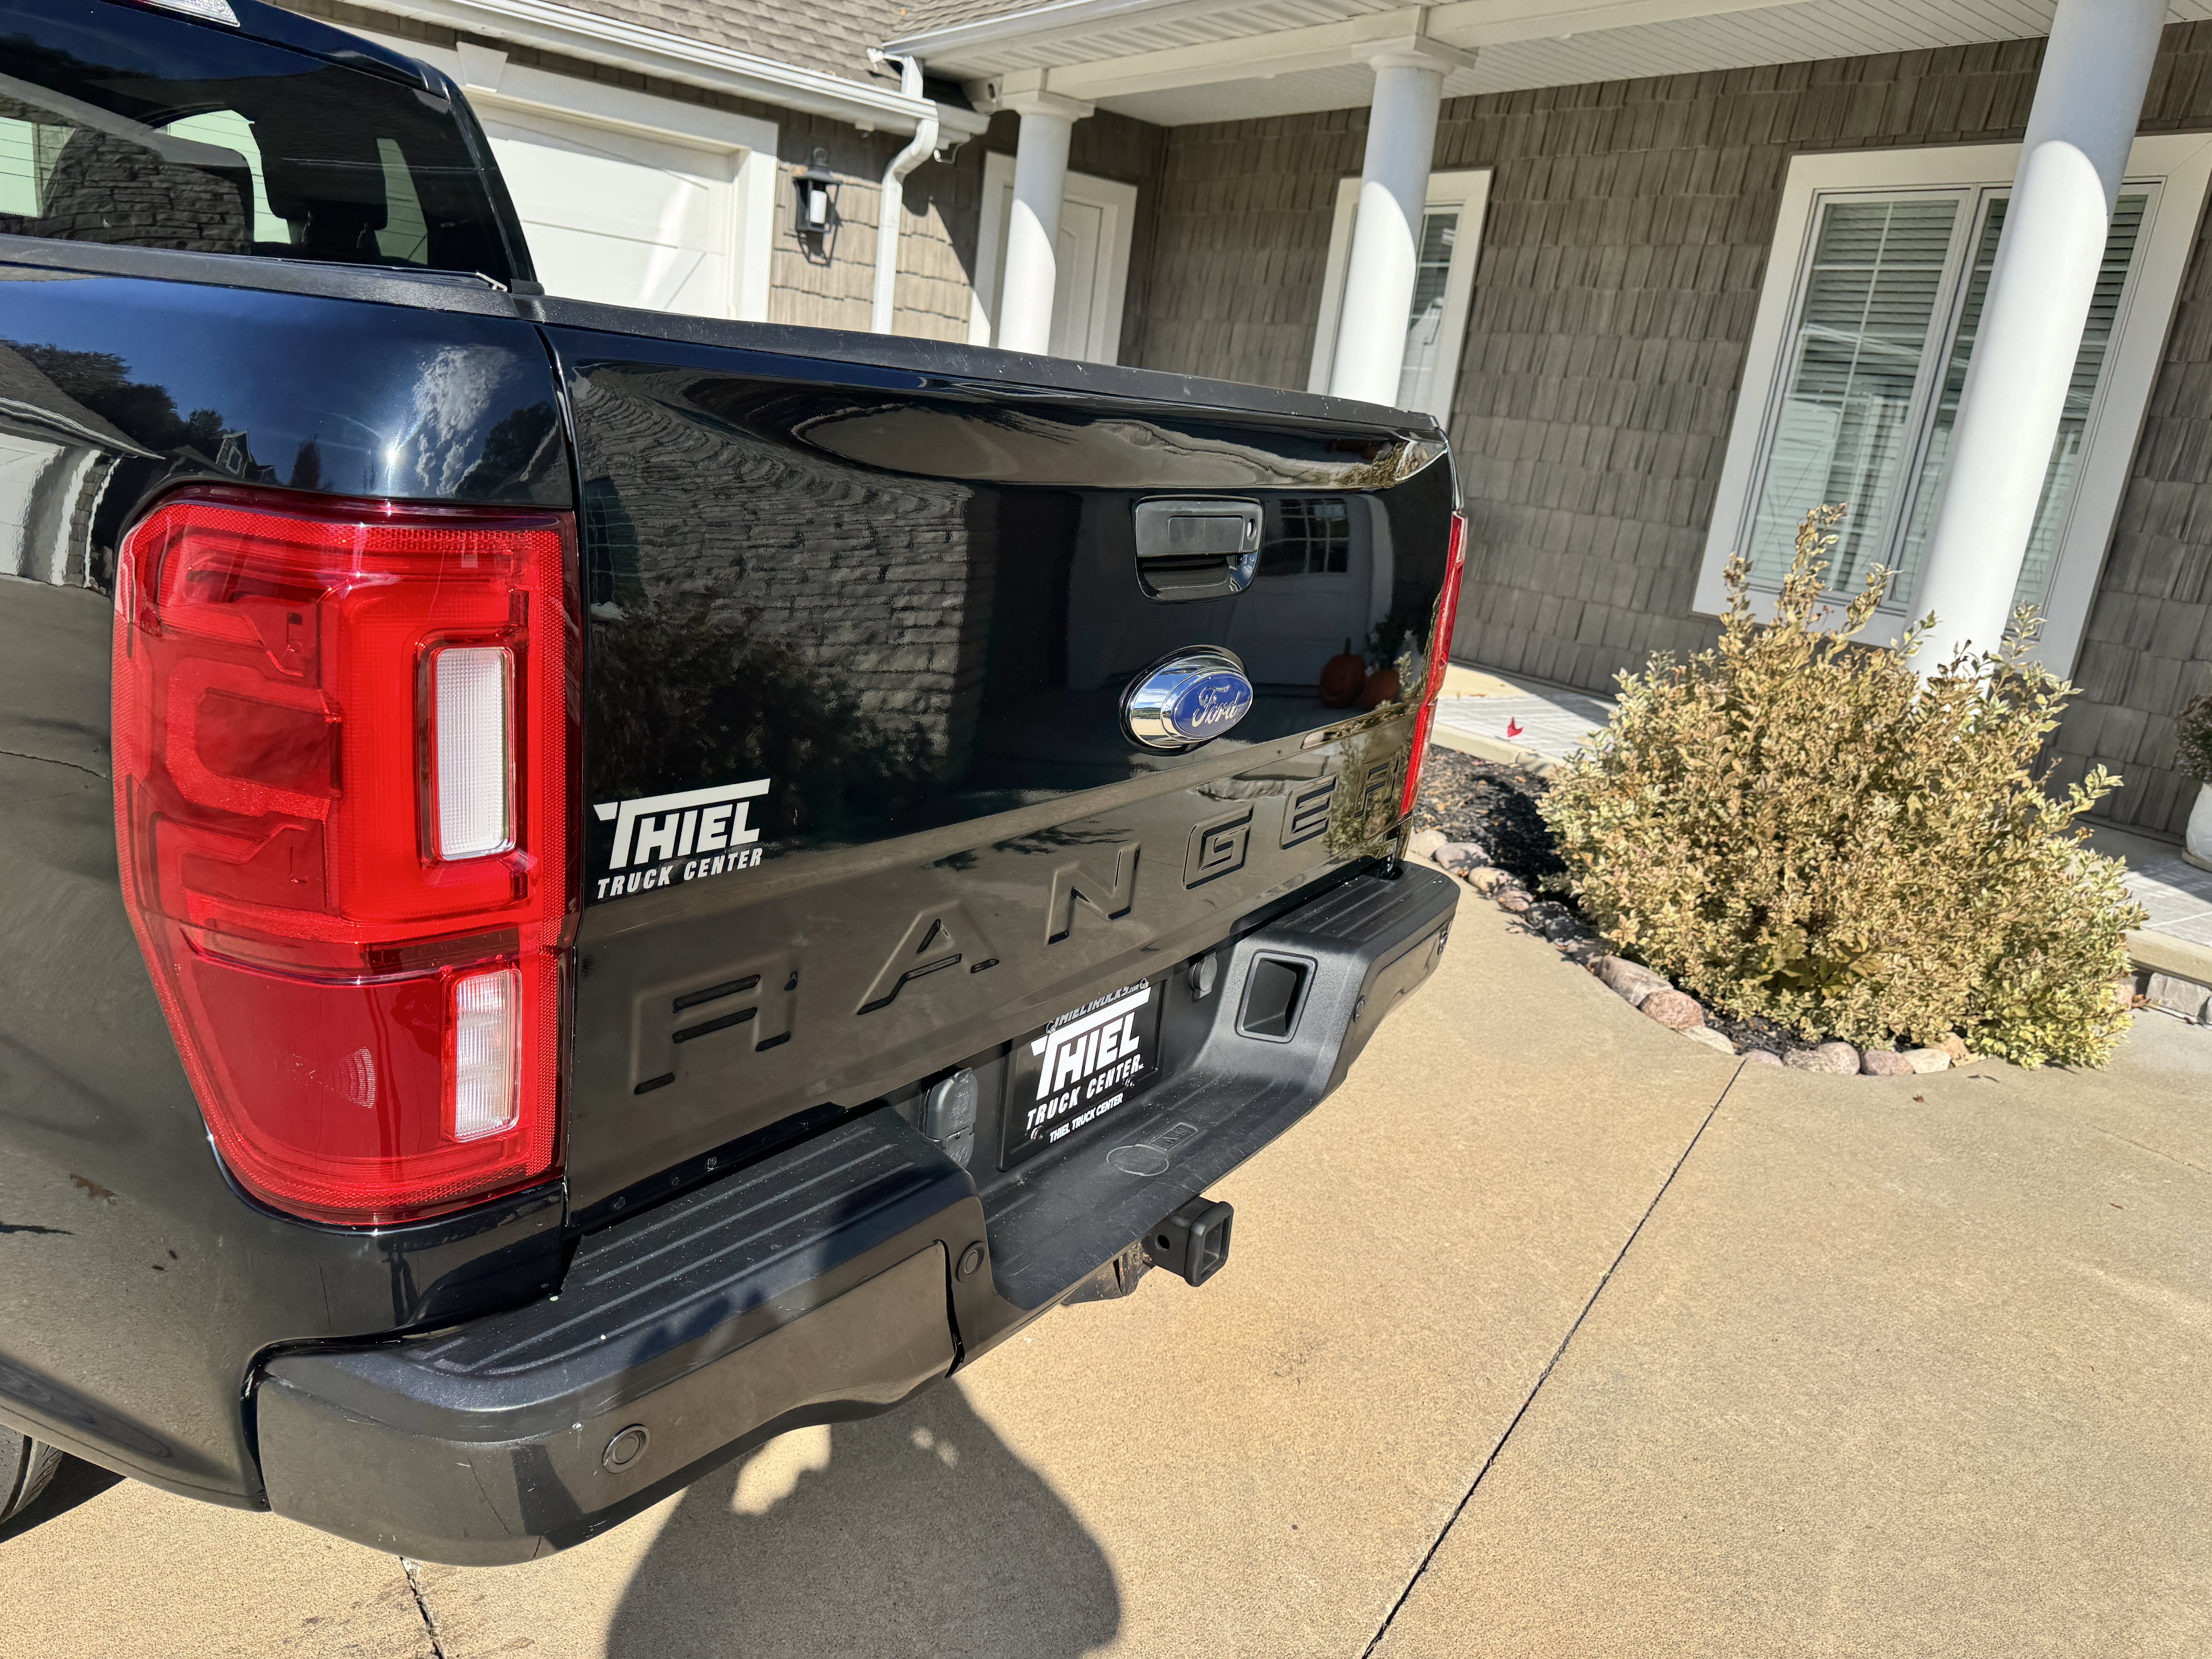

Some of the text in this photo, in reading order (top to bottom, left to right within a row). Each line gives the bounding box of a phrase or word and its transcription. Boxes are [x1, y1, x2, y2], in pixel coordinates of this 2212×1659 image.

[1192, 685, 1241, 727] Ford
[593, 778, 770, 869] THIEL
[598, 848, 762, 898] TRUCK CENTER
[627, 750, 1401, 1096] RANGER
[1030, 987, 1151, 1101] THIEL
[1026, 1054, 1140, 1130] TRUCK CENTER
[1050, 1092, 1123, 1143] THIEL TRUCK CENTER
